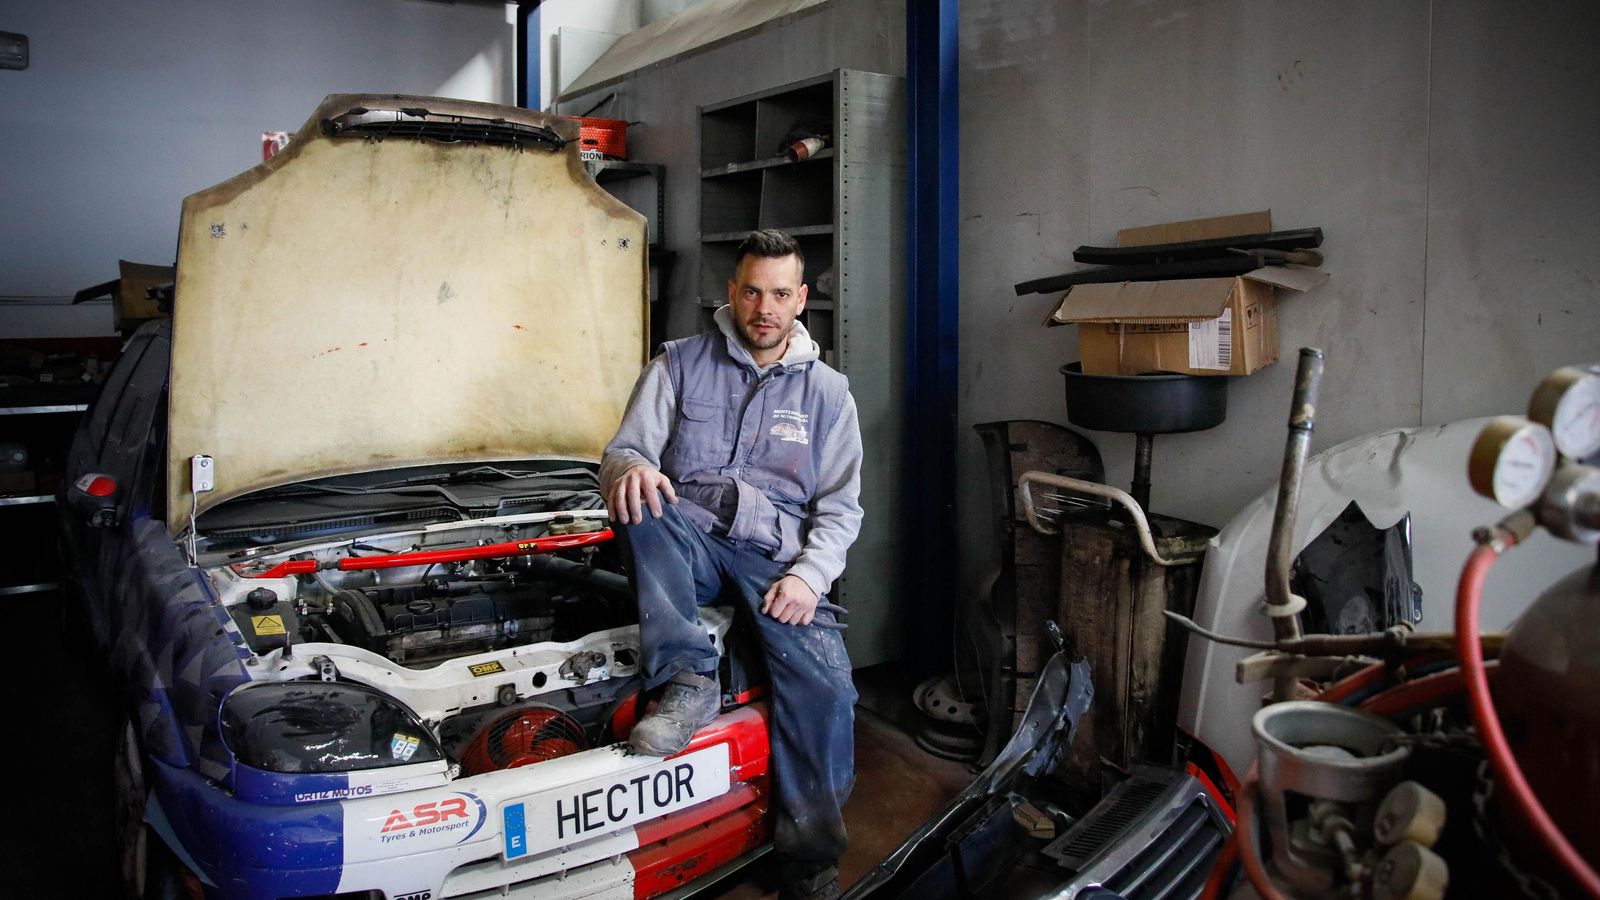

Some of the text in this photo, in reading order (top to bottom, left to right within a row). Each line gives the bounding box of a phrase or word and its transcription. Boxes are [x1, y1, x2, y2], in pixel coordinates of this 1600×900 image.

[474, 663, 499, 673] OMP
[296, 790, 330, 801] ORTIZ
[332, 785, 373, 798] MOTOS
[556, 763, 695, 839] HECTOR
[380, 798, 470, 833] ASR
[381, 833, 406, 843] Tyres
[419, 820, 469, 836] Motorsport
[511, 835, 521, 848] E
